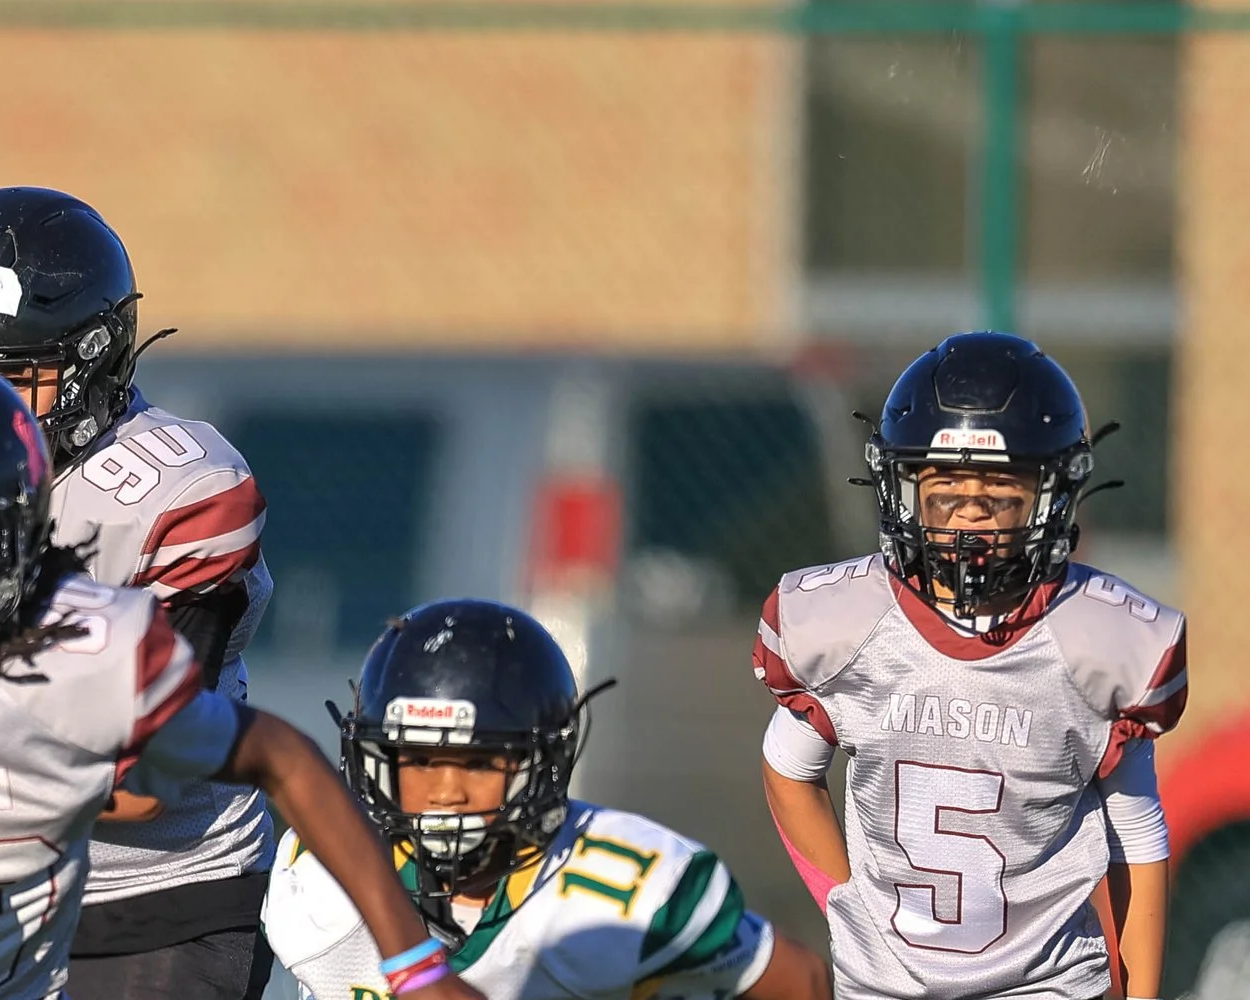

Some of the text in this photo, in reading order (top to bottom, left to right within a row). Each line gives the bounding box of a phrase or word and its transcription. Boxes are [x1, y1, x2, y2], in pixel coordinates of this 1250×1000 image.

[81, 423, 208, 506] 90
[940, 433, 997, 446] Ridell
[881, 692, 1033, 748] MASON
[558, 834, 664, 921] 11
[890, 760, 1008, 954] 5
